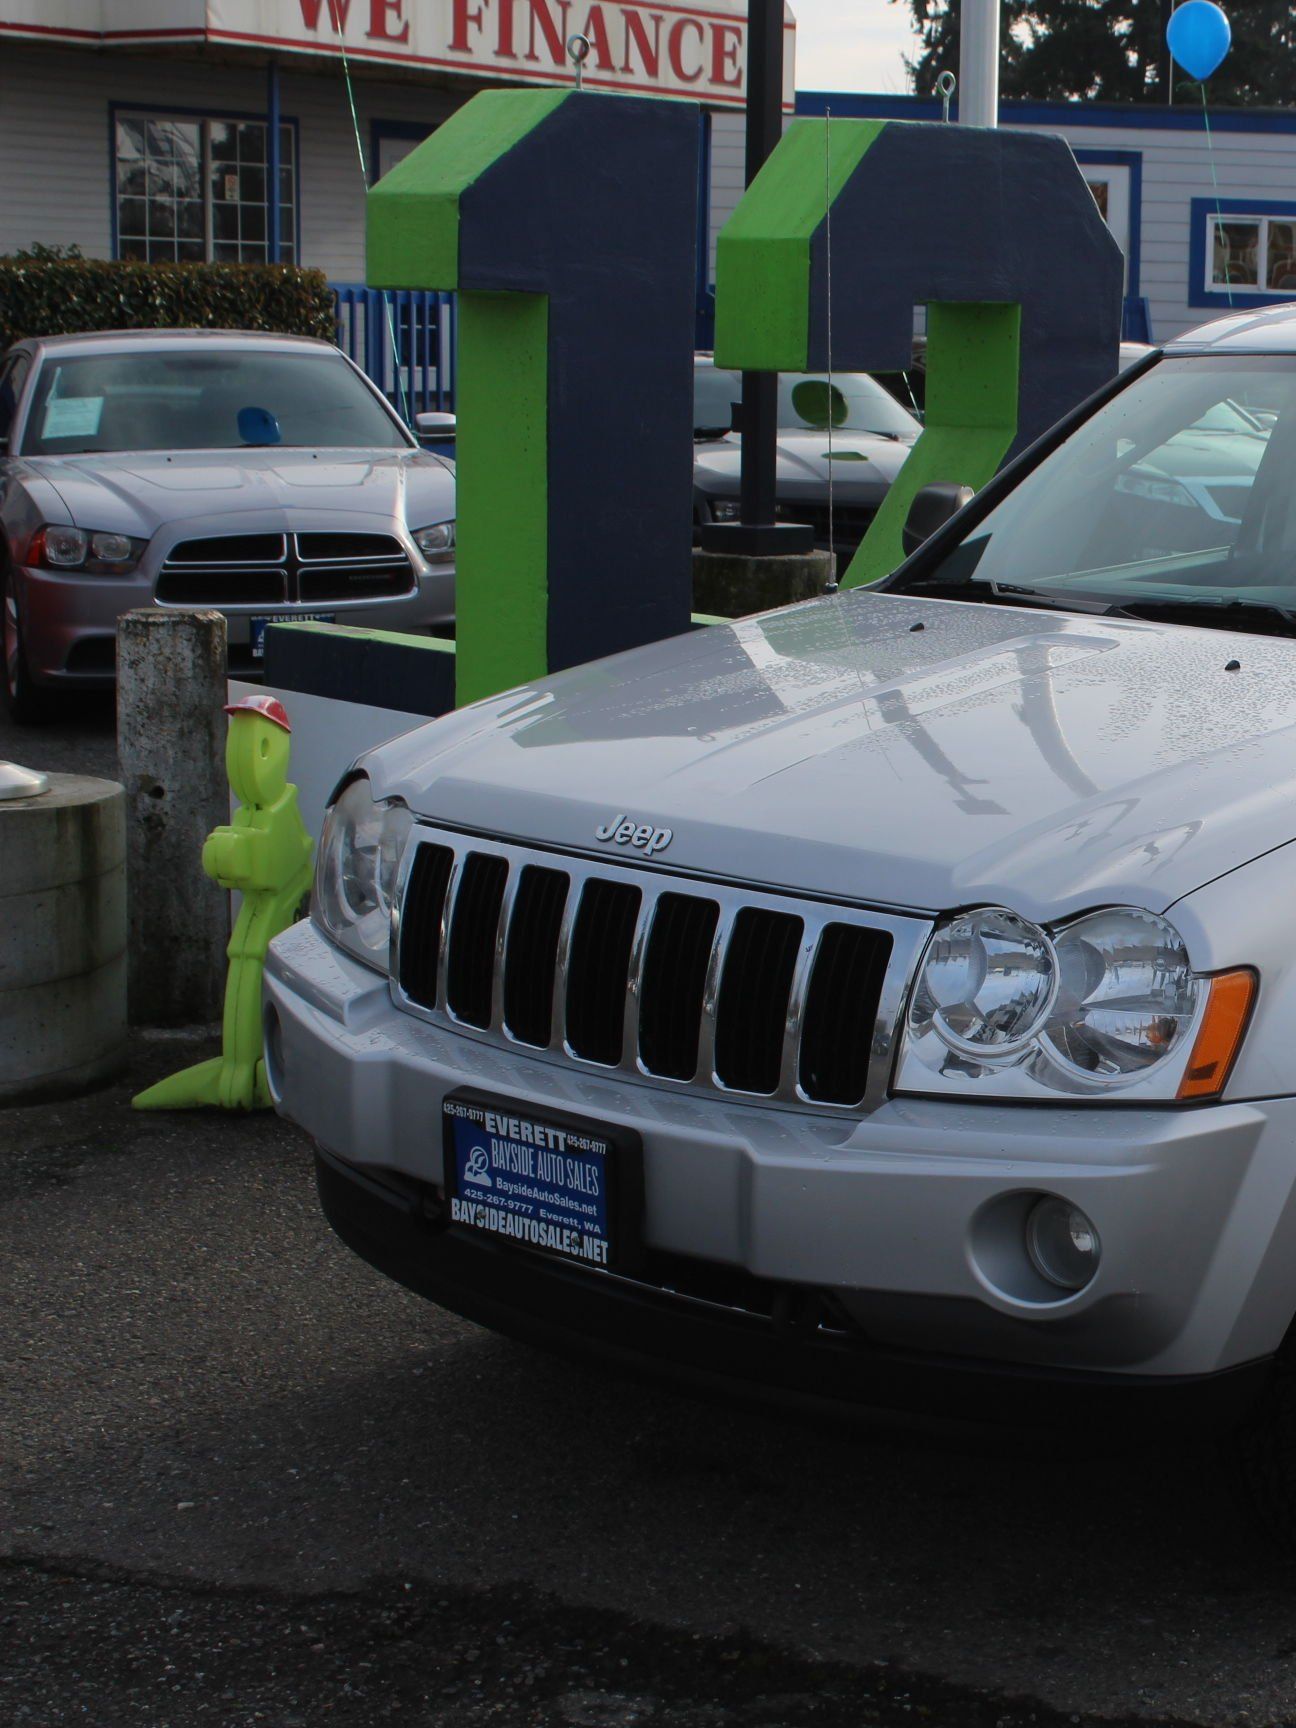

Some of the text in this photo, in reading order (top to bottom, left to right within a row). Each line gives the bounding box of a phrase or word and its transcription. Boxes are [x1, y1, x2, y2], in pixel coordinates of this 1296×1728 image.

[292, 0, 745, 88] WE FINANCE
[595, 813, 674, 857] Jeep
[485, 1111, 568, 1152] EVERETT
[491, 1138, 600, 1196] BAYSIDE AUTO SALES
[464, 1188, 601, 1234] 425-267-9777 Everett, WA
[496, 1177, 598, 1216] BaysideAutoSales.net
[451, 1198, 609, 1264] BAYSIDEAUTOSALES.NET
